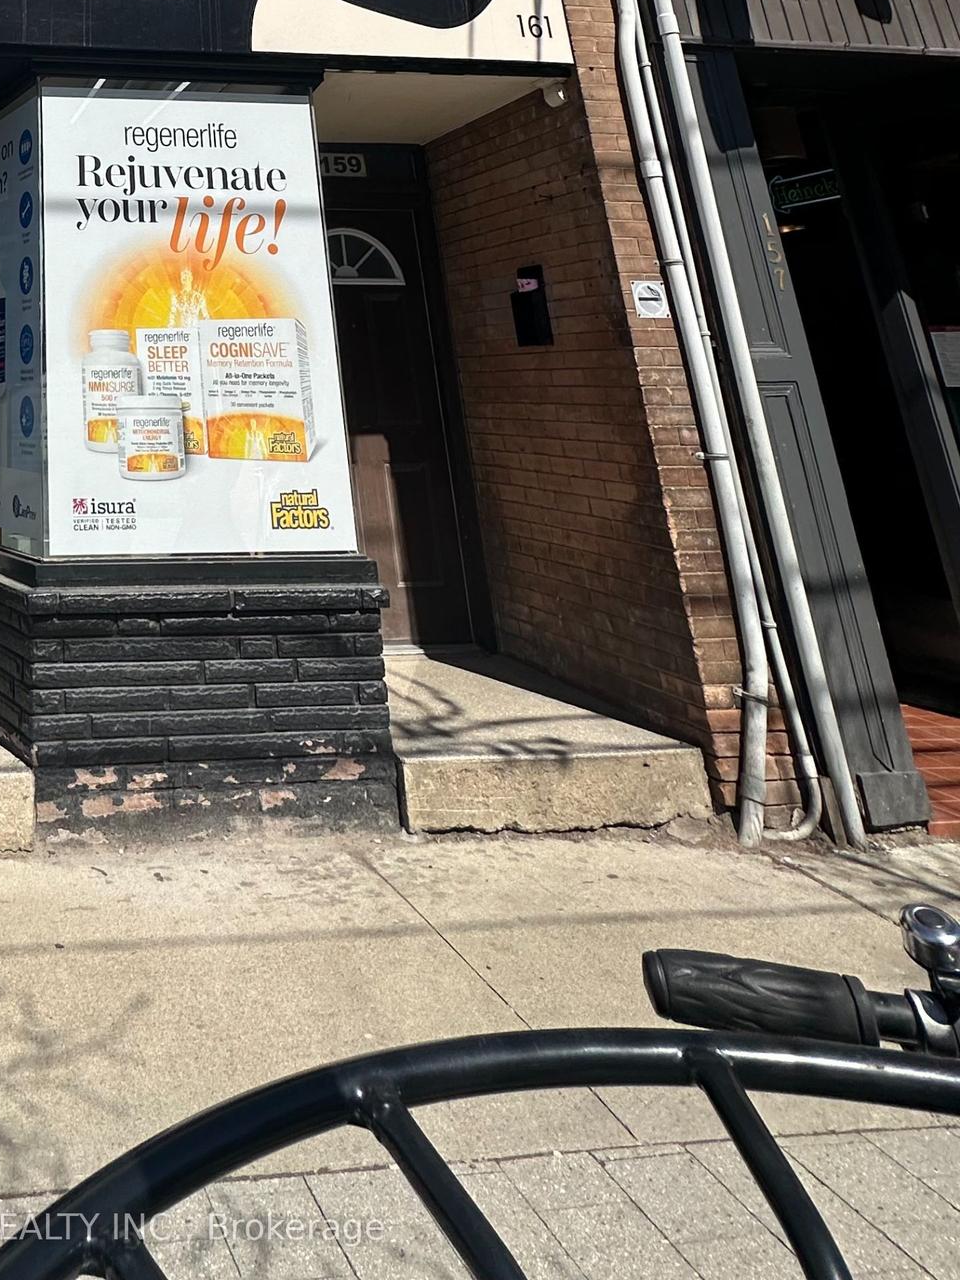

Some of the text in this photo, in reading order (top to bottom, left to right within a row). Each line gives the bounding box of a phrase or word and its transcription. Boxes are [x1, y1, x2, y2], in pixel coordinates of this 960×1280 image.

[516, 14, 553, 39] 161
[124, 122, 238, 153] regenerlife
[1, 140, 14, 161] on
[320, 155, 363, 174] 159
[75, 153, 288, 196] Rejuvenate
[76, 194, 288, 272] your life!
[144, 330, 190, 345] regenerlife
[217, 322, 274, 341] regenerlife
[147, 345, 188, 360] SLEEP
[209, 342, 288, 358] COGNISAVE
[148, 360, 189, 373] BETTER
[207, 360, 233, 369] Memory
[266, 359, 293, 368] Formula
[90, 368, 133, 381] regenerlife
[268, 437, 302, 454] Factors
[90, 497, 136, 515] isura
[280, 489, 319, 507] natural
[270, 500, 330, 530] Factors
[73, 523, 100, 531] CLEAN
